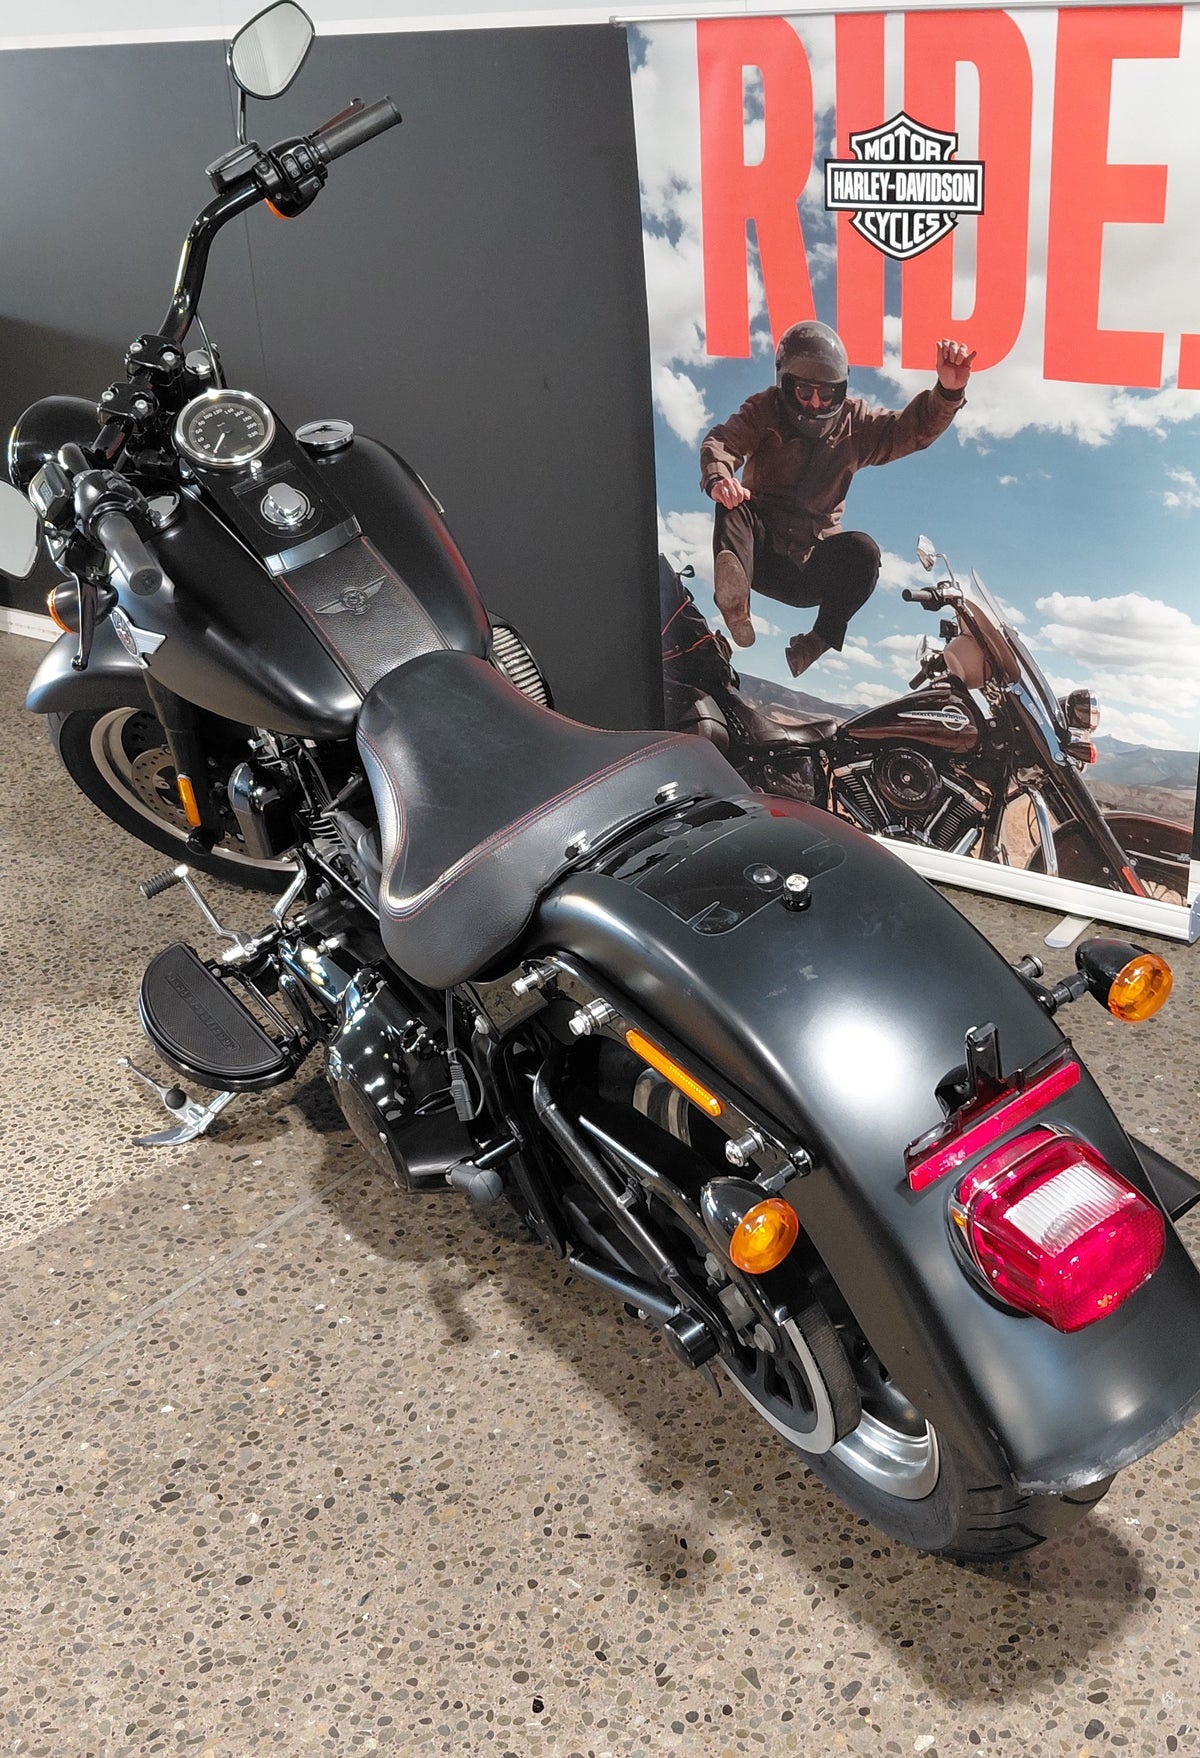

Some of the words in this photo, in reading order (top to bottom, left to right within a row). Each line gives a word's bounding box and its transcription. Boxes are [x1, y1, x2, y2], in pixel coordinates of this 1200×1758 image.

[864, 125, 941, 161] MOTOR
[833, 171, 975, 203] HARLEY-DAVIDSON
[864, 211, 941, 250] CYCLES
